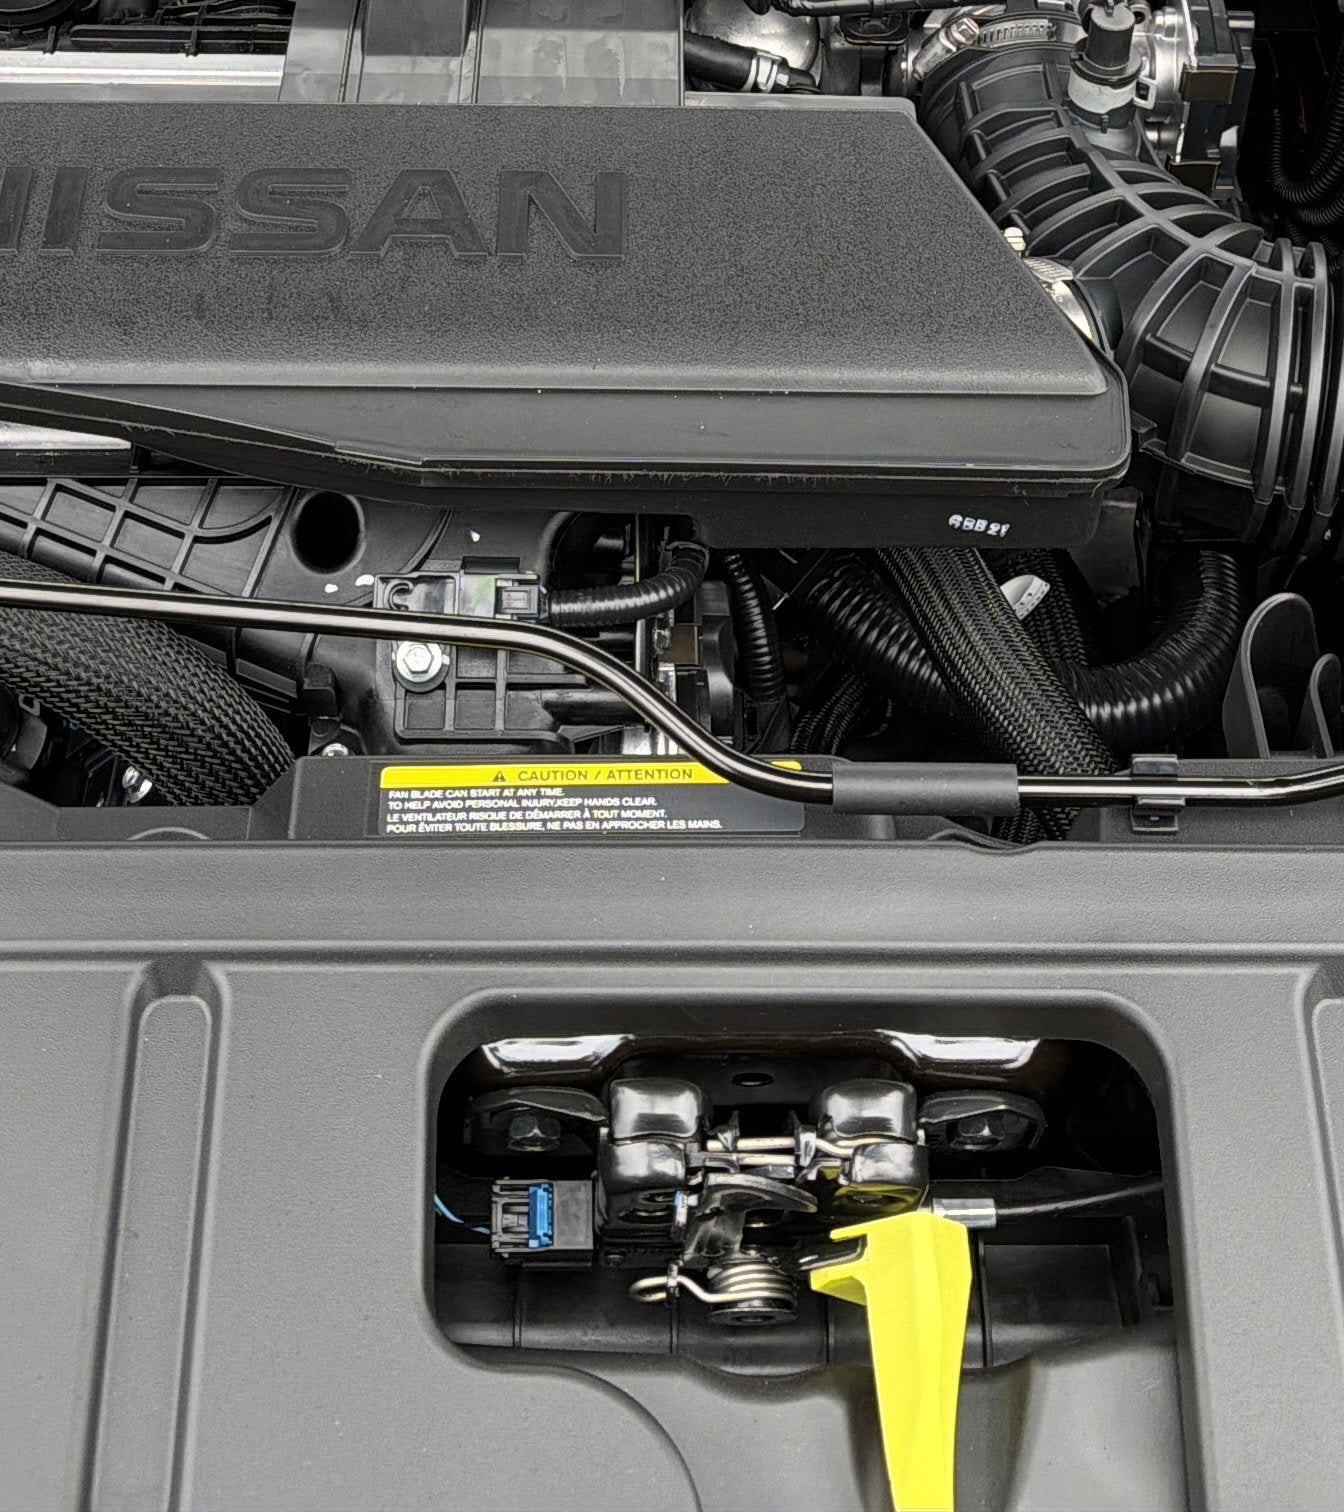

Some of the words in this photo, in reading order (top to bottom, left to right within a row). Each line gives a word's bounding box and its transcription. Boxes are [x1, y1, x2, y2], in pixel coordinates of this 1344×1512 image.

[518, 769, 588, 782] CAUTION
[607, 768, 694, 781] ATTENTION
[389, 791, 408, 799] FAN
[411, 790, 443, 799] BLADE
[445, 790, 468, 798] CAN
[470, 789, 500, 798] START
[502, 789, 515, 797] AT
[517, 788, 538, 797] ANY
[540, 788, 565, 796] TIME.
[387, 801, 403, 810] TO
[405, 801, 431, 810] HELP
[432, 800, 463, 809] AVOID
[465, 799, 519, 808] PERSONAL
[584, 798, 620, 807] HANDS
[622, 797, 658, 806] CLEAR.
[387, 813, 400, 822] LE
[402, 812, 467, 822] VENTILATEUR
[469, 811, 508, 821] RISQUE
[509, 811, 524, 820] DE
[526, 808, 581, 819] DÉMARRER
[583, 808, 591, 819] À
[593, 810, 619, 819] TOUT
[621, 809, 668, 818] MOMENT.
[387, 824, 417, 833] POUR
[419, 822, 453, 832] ÉVITER
[456, 823, 488, 832] TOUTE
[490, 822, 545, 832] BLESSURE,
[547, 821, 561, 830] NE
[563, 821, 583, 830] PAS
[586, 821, 600, 830] EN
[601, 820, 666, 830] APPROCHER
[667, 820, 686, 829] LES
[688, 820, 723, 829] MAINS.
